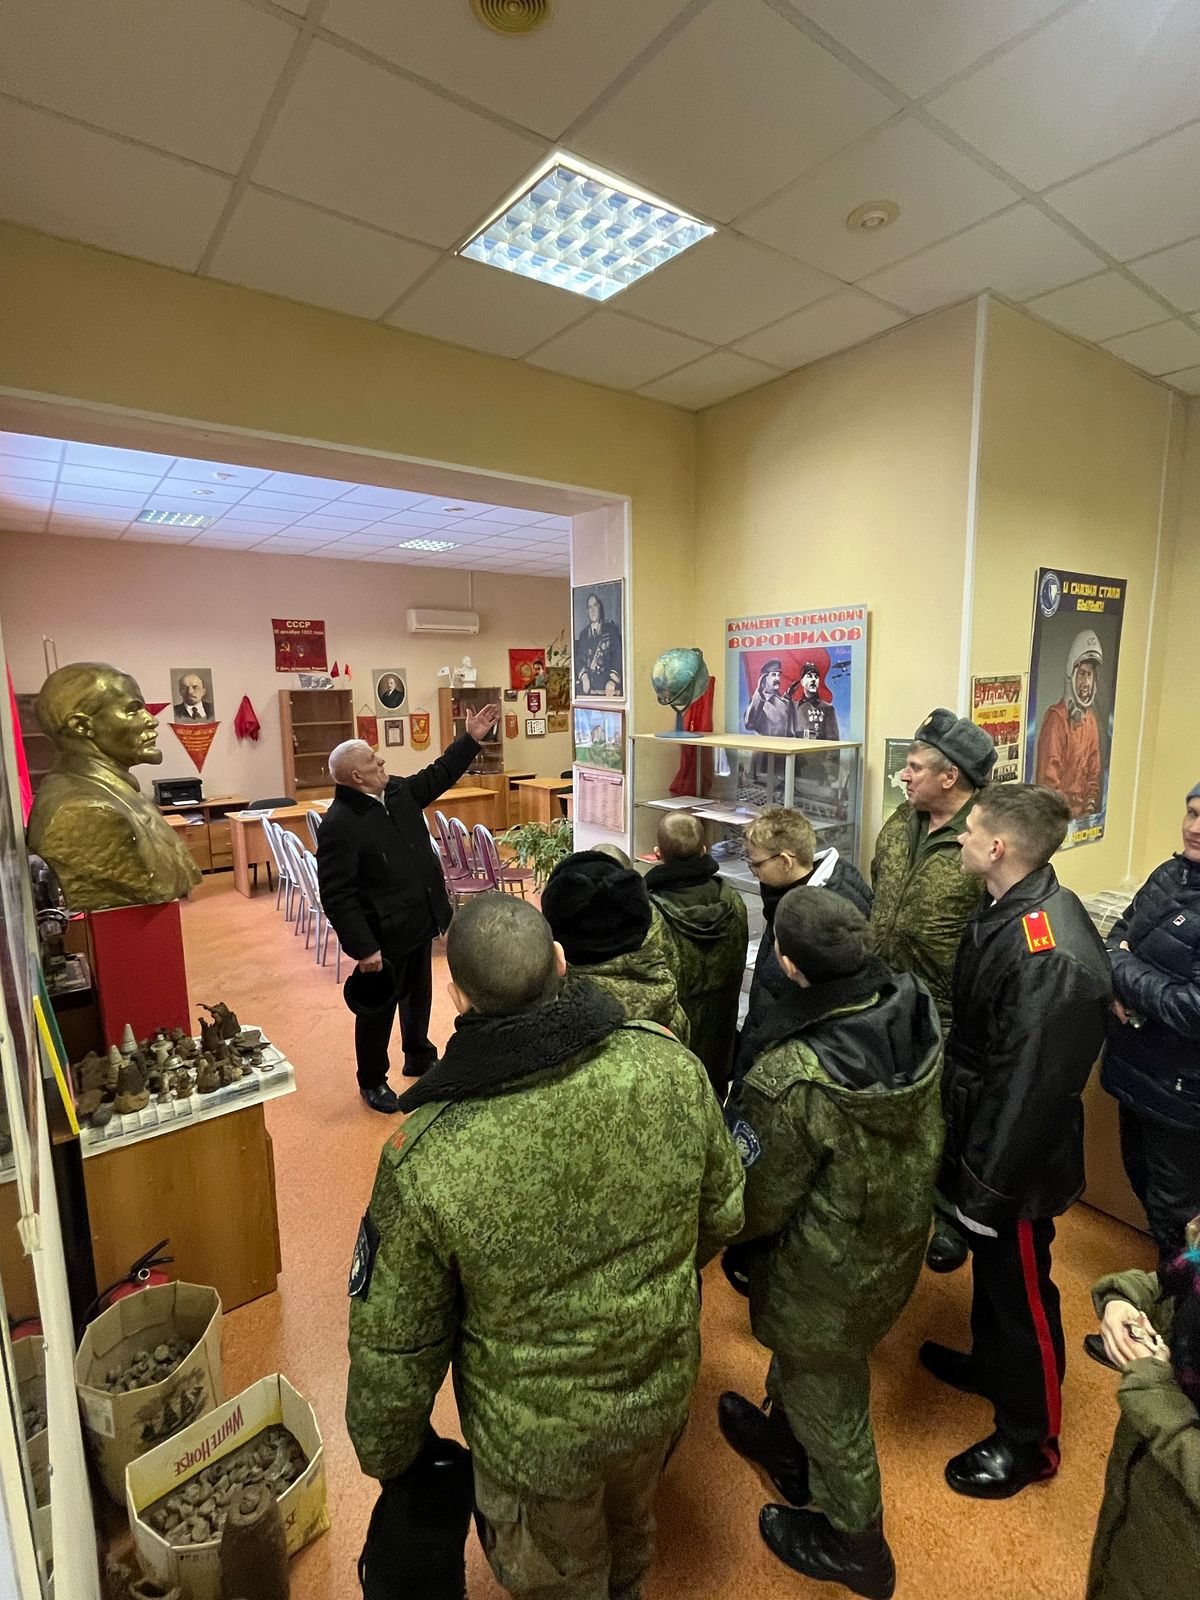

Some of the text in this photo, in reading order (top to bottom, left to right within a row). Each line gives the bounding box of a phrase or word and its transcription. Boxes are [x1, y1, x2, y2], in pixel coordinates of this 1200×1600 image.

[1098, 586, 1121, 599] СТАЛА
[286, 620, 311, 629] СССР
[727, 609, 864, 633] КЛИМЕНТ ЕФРЕМОВИЧ
[728, 627, 862, 649] ВОРОШИЛОВ
[174, 1437, 212, 1478] HORSE
